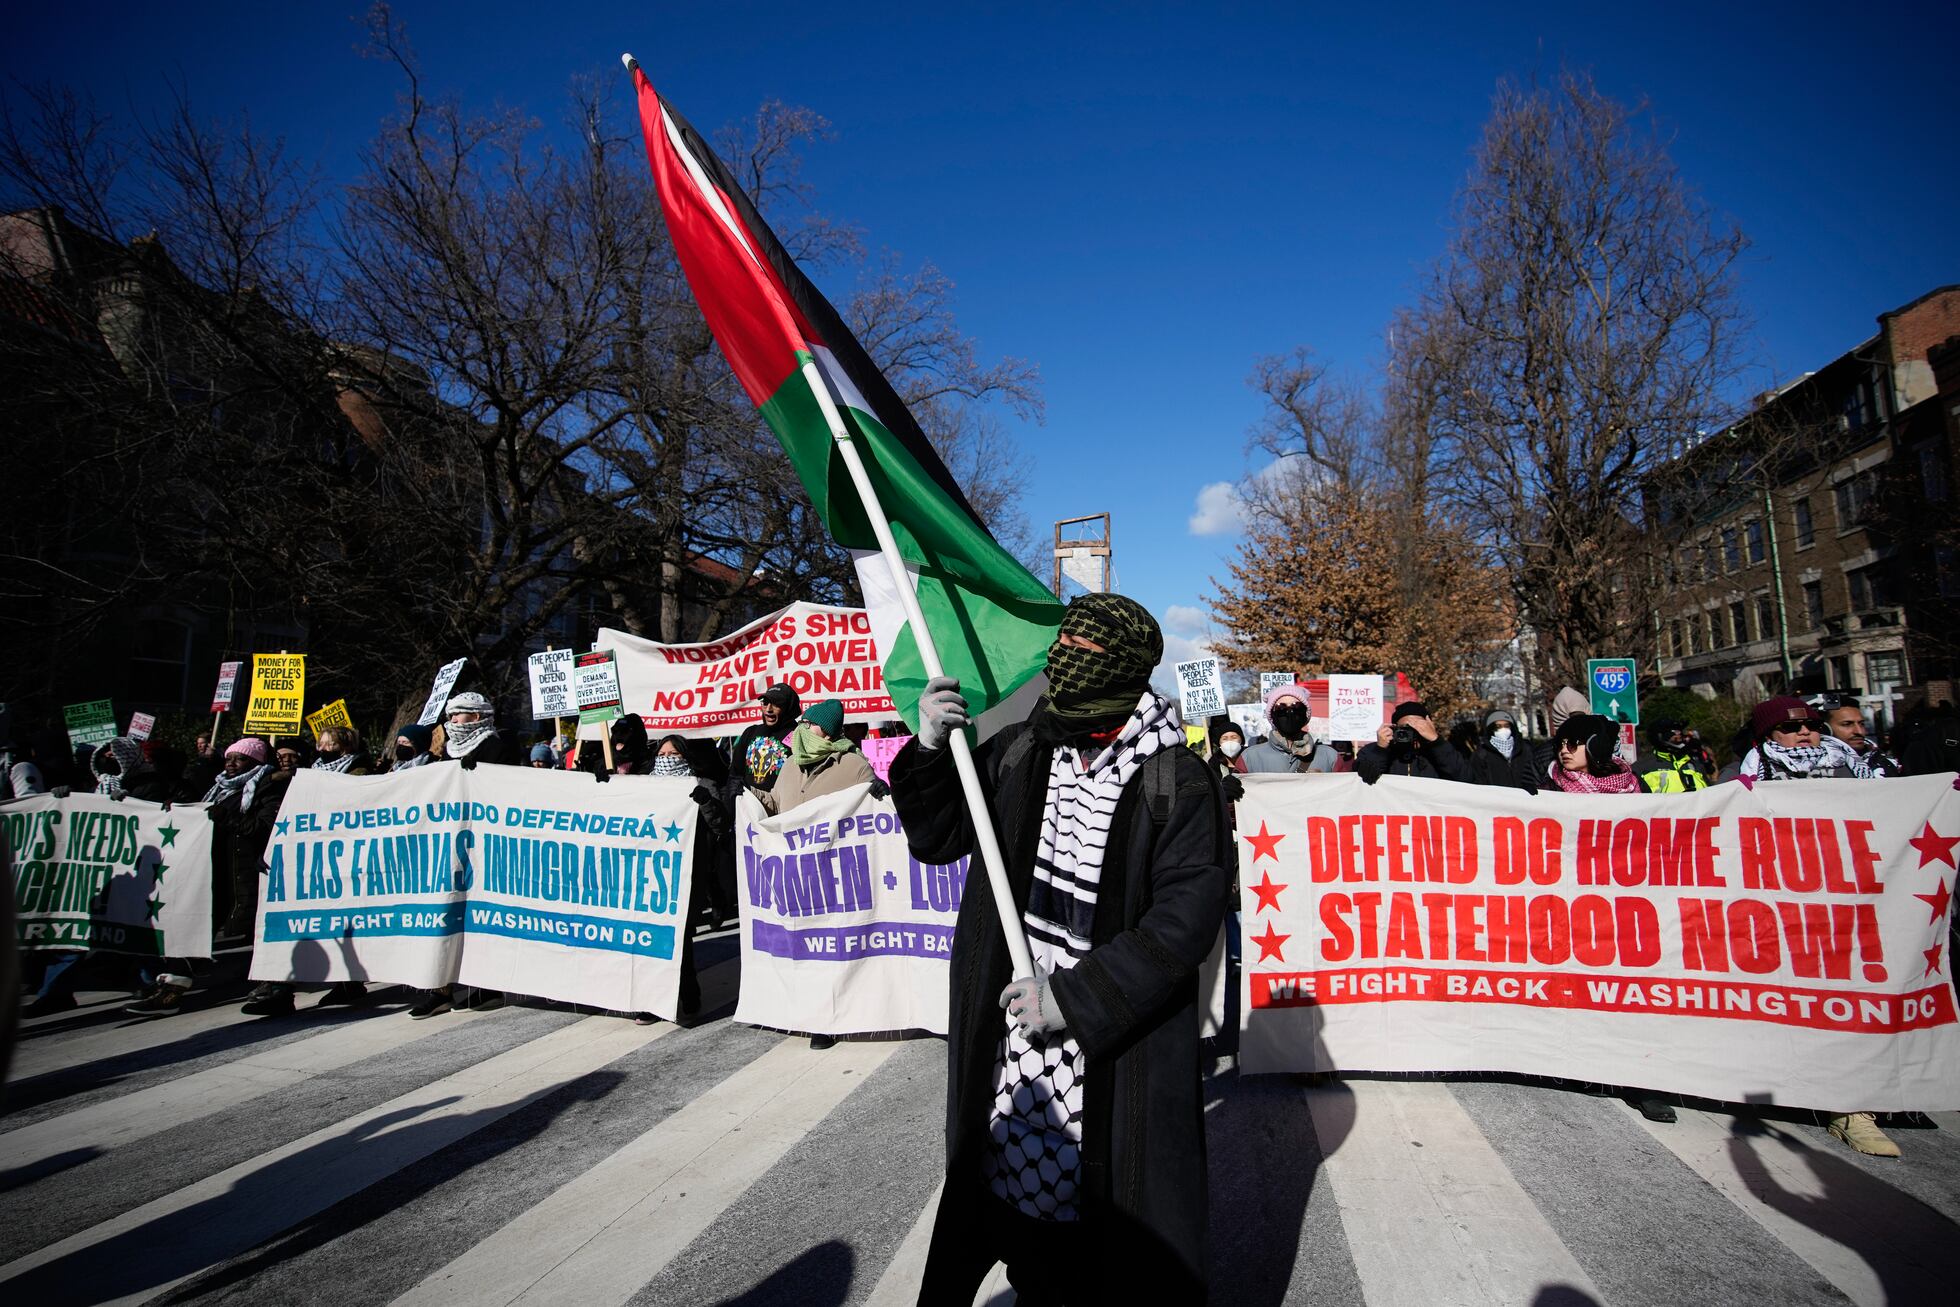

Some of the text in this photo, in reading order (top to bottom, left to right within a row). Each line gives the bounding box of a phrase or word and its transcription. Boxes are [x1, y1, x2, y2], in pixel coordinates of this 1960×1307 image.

[657, 616, 797, 664] WORKERS
[258, 657, 301, 668] MONEY FOR
[530, 651, 571, 665] THE PEOPLE
[257, 667, 301, 679] PEOPLE'S
[543, 663, 560, 673] WILL
[697, 650, 770, 684] HAVE
[1178, 659, 1215, 673] MONEY FOR
[538, 672, 566, 684] DEFEND
[582, 672, 608, 683] DEMAND
[1182, 668, 1213, 680] PEOPLE'S
[1601, 673, 1625, 689] 495
[263, 679, 294, 691] NEEDS
[540, 684, 568, 695] WOMEN &
[577, 684, 617, 698] OVER POLICE
[1354, 688, 1370, 696] NOT
[653, 687, 714, 711] NOT
[1186, 687, 1215, 699] NOT THE
[1186, 694, 1219, 706] U.S. WAR
[253, 697, 299, 711] NOT THE
[544, 701, 567, 712] RIGHTS!
[1186, 701, 1221, 713] MACHINE!
[1335, 697, 1376, 706] TOO LATE
[64, 701, 111, 717] FREE THE
[251, 710, 298, 719] WAR MACHINE!
[313, 710, 345, 732] UNITED
[676, 715, 699, 725] FOR
[70, 729, 117, 744] POLITICAL
[295, 801, 657, 840] EL PUEBLO UNIDO DEFENDERÁ
[783, 822, 830, 851] THE
[1306, 814, 1884, 894] DEFEND DC HOME RULE
[267, 830, 682, 916] A LAS FAMILIAS INMIGRANTES!
[743, 844, 873, 918] WOMEN
[883, 870, 898, 891] +
[288, 917, 321, 934] WE
[330, 912, 392, 933] FIGHT
[402, 911, 447, 928] BACK
[471, 909, 615, 943] WASHINGTON
[622, 929, 653, 947] DC
[803, 931, 954, 953] WE FIGHT BA
[1319, 891, 1888, 983] STATEHOOD NOW!
[1268, 977, 1316, 1000] WE
[1329, 974, 1431, 996] FIGHT
[1447, 975, 1549, 1000] BACK
[1587, 980, 1891, 1025] WASHINGTON
[1902, 994, 1936, 1022] DC
